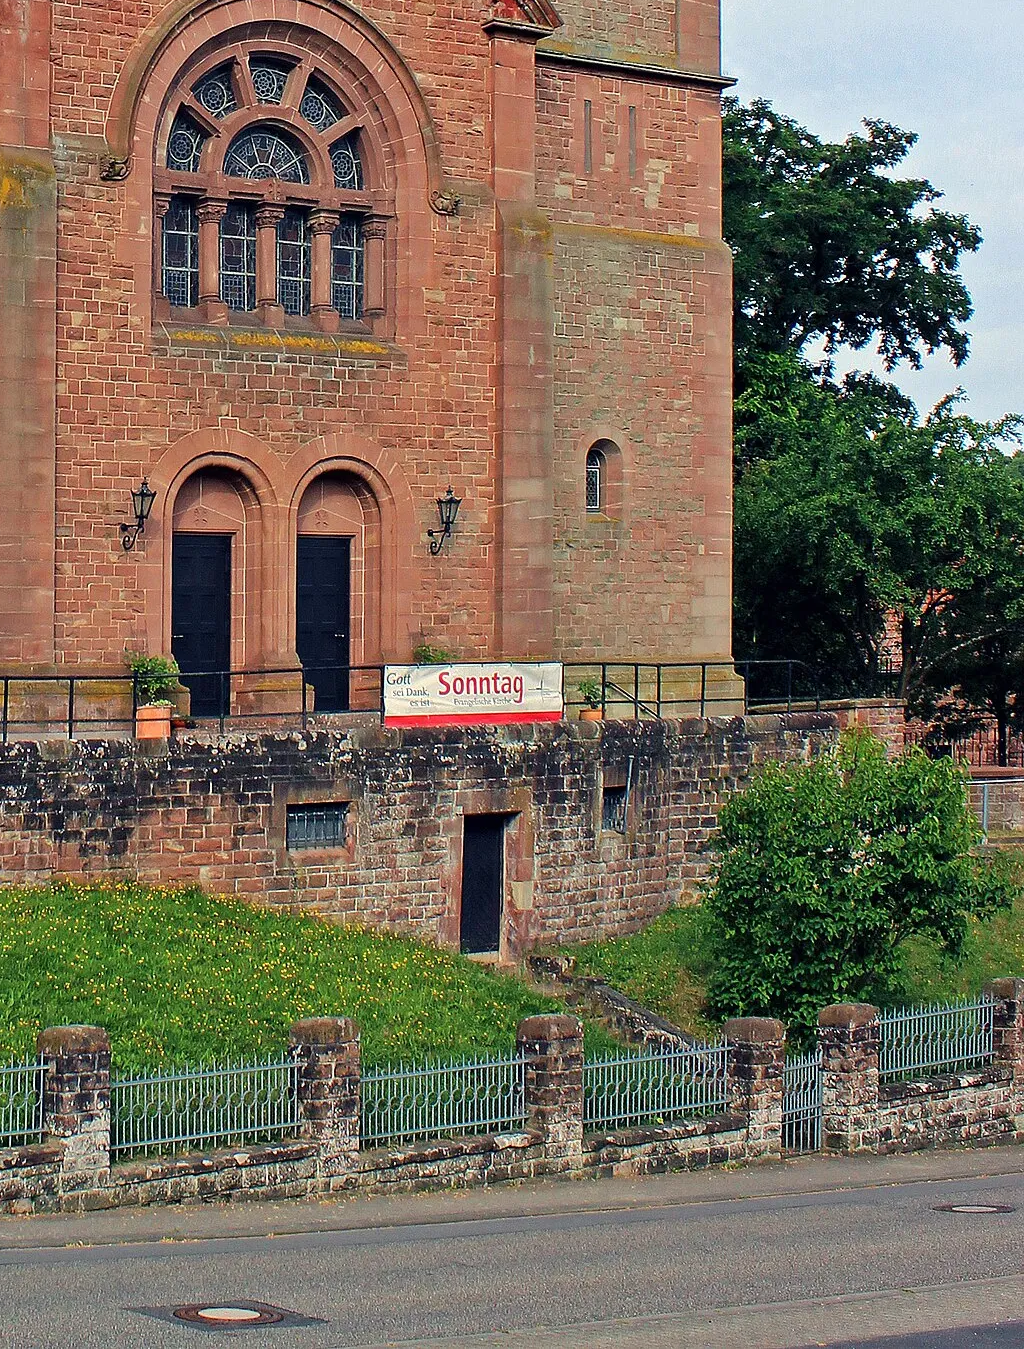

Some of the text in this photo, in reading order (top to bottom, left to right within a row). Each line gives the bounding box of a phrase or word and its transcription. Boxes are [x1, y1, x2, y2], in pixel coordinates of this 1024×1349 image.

[386, 672, 411, 685] Gott
[392, 686, 429, 698] sei Dank,
[438, 671, 523, 704] Sonntag
[409, 698, 431, 707] es ist
